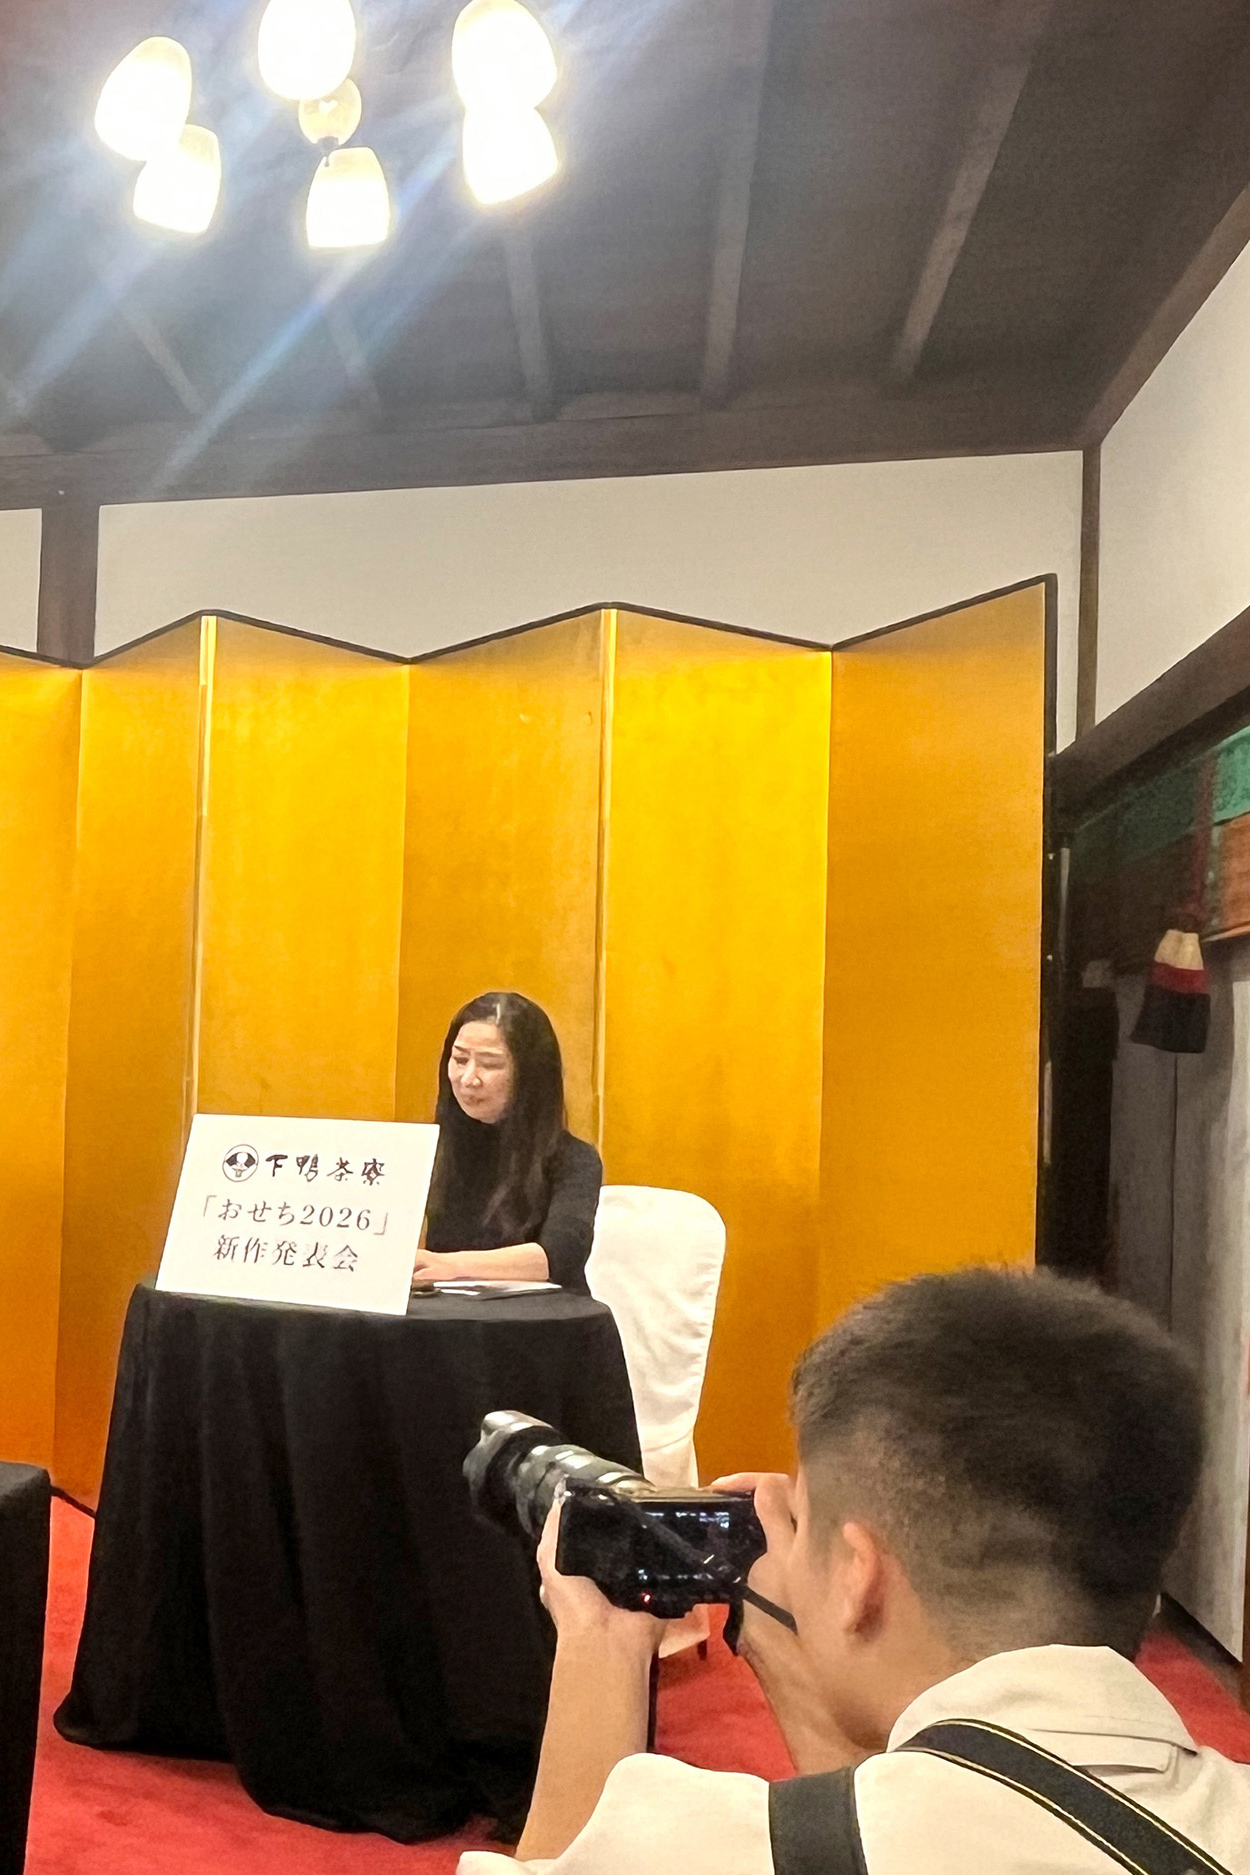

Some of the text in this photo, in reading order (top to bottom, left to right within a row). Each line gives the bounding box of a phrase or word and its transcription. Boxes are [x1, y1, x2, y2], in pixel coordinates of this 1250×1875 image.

[265, 1153, 385, 1186] 下鴨茶寮
[203, 1195, 388, 1235] 「おせち2026」
[214, 1234, 358, 1272] 新作発表会
